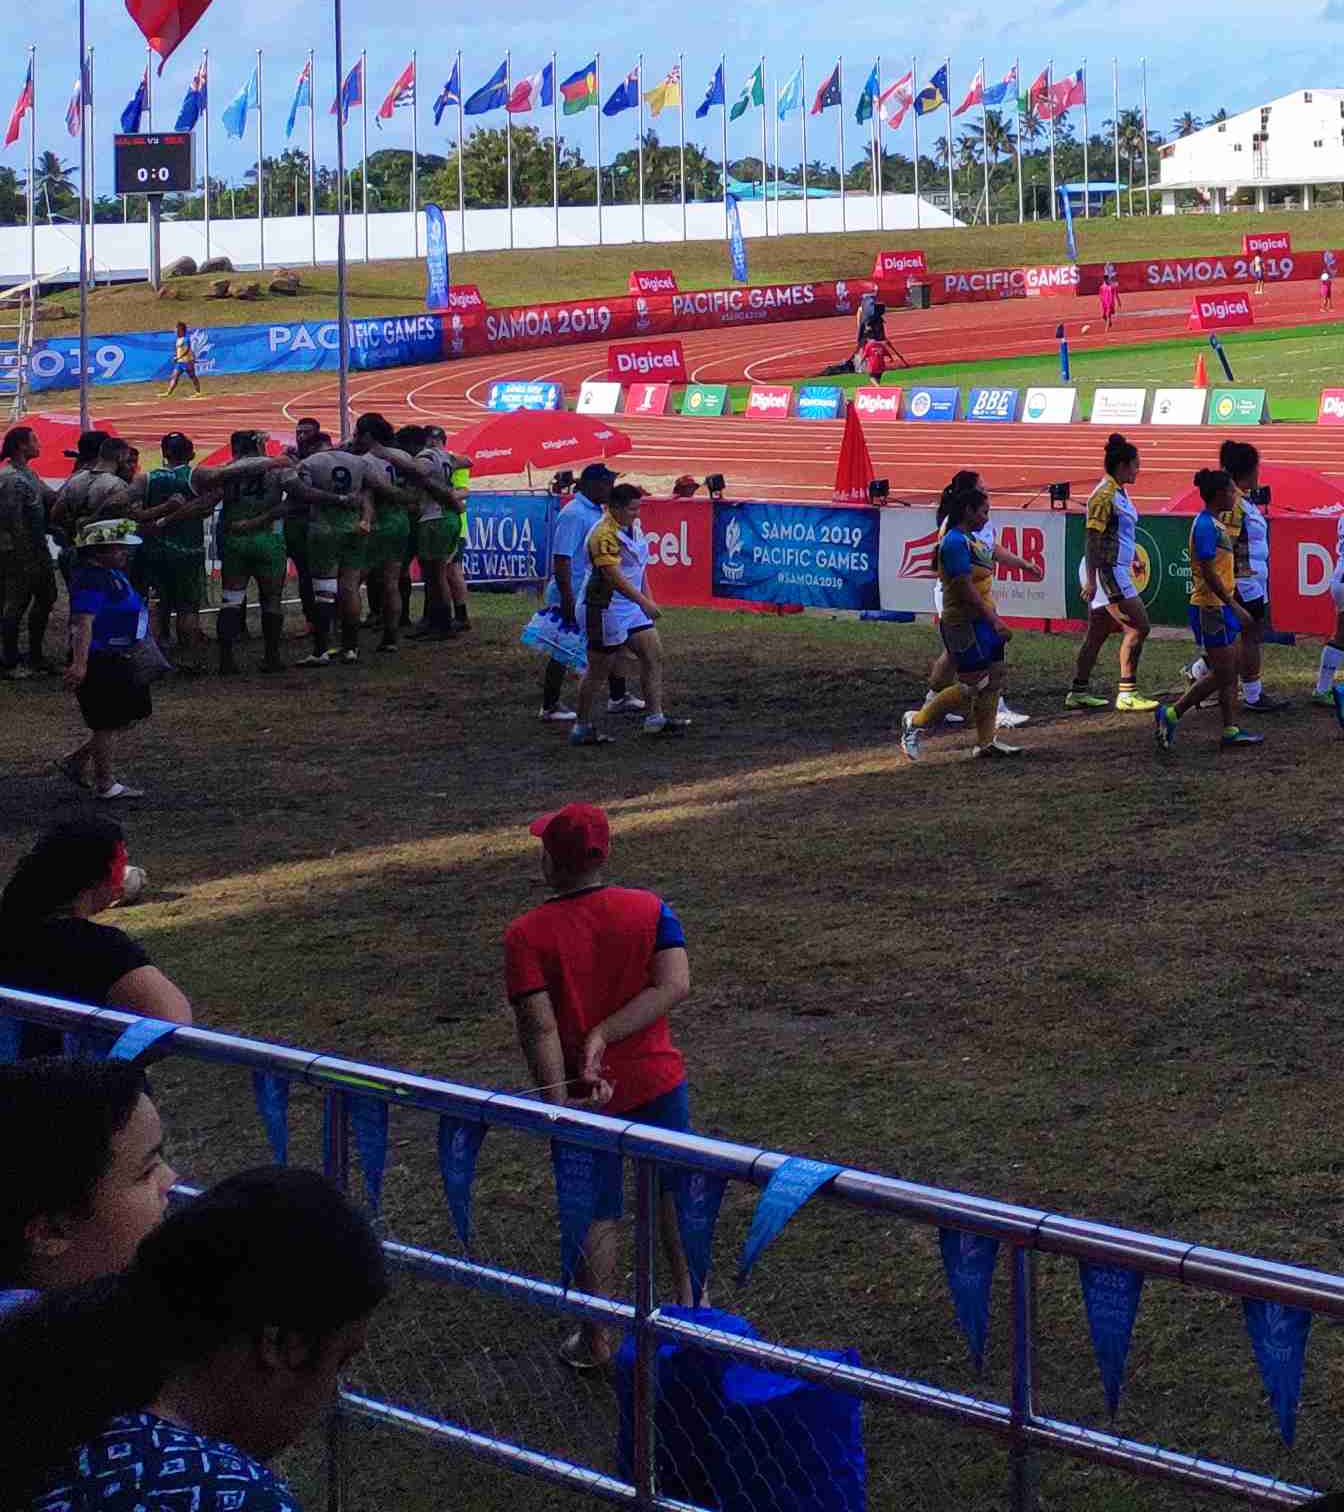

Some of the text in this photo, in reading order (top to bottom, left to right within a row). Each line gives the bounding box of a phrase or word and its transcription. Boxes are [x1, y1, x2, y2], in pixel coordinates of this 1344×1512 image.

[1250, 237, 1288, 252] Digicel
[884, 256, 923, 271] Digicel
[1147, 262, 1227, 285] SAMOA
[639, 276, 675, 292] Digicel
[944, 265, 1081, 293] PACIFIC GAMES
[673, 289, 743, 317] PACIFIC
[749, 284, 815, 310] GAMES
[1200, 299, 1248, 320] Digicel
[384, 315, 434, 345] GAMES
[487, 304, 611, 341] SAMOA 2019
[617, 349, 680, 373] Digicel
[750, 389, 787, 409] Digicel
[858, 392, 897, 413] Digicel
[976, 390, 1012, 409] BBE
[463, 517, 537, 553] AMOA
[761, 521, 863, 549] SAMOA 2019
[484, 552, 538, 577] WATER
[753, 545, 870, 572] PACIFIC GAMES
